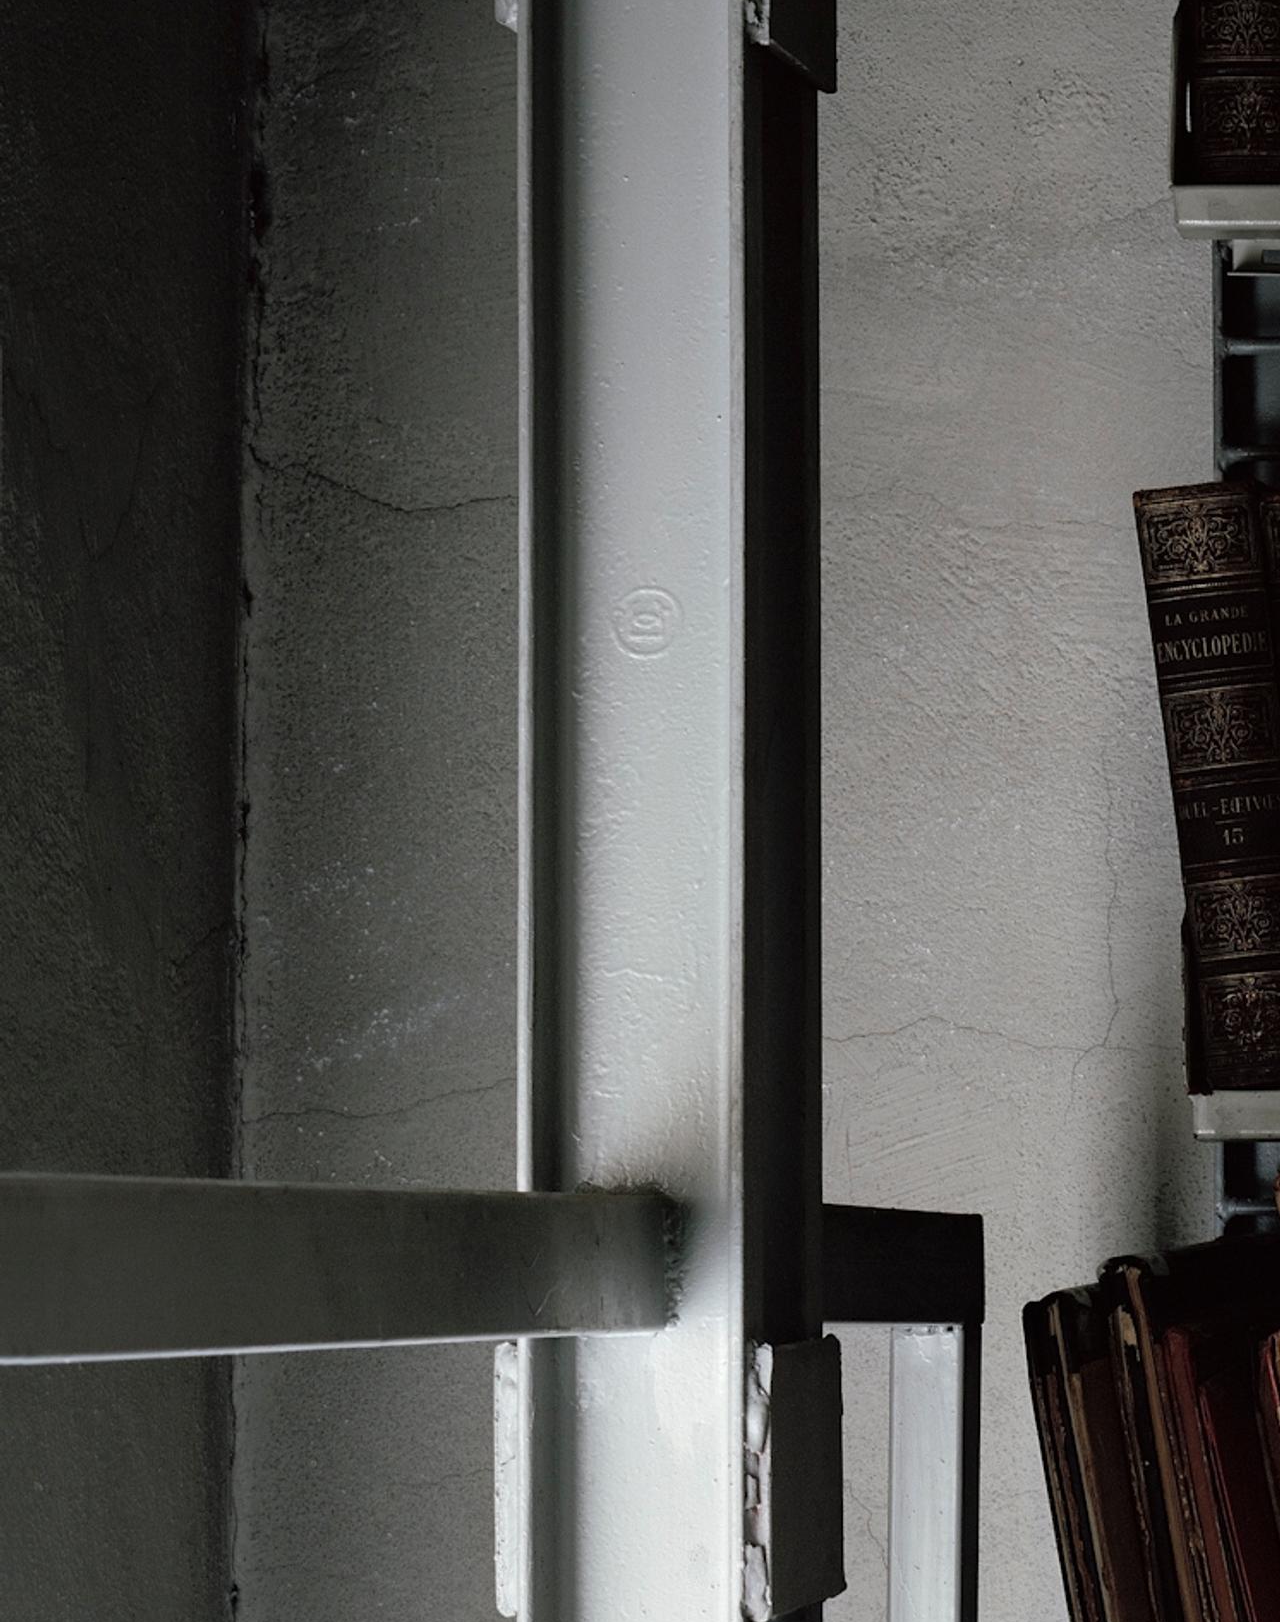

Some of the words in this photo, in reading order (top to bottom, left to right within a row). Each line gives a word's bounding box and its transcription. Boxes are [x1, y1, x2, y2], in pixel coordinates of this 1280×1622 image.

[1165, 613, 1183, 627] LA
[1188, 605, 1249, 624] GRANDE
[1156, 629, 1269, 664] ENCYCLOPÉDIE
[1221, 828, 1244, 846] 15
